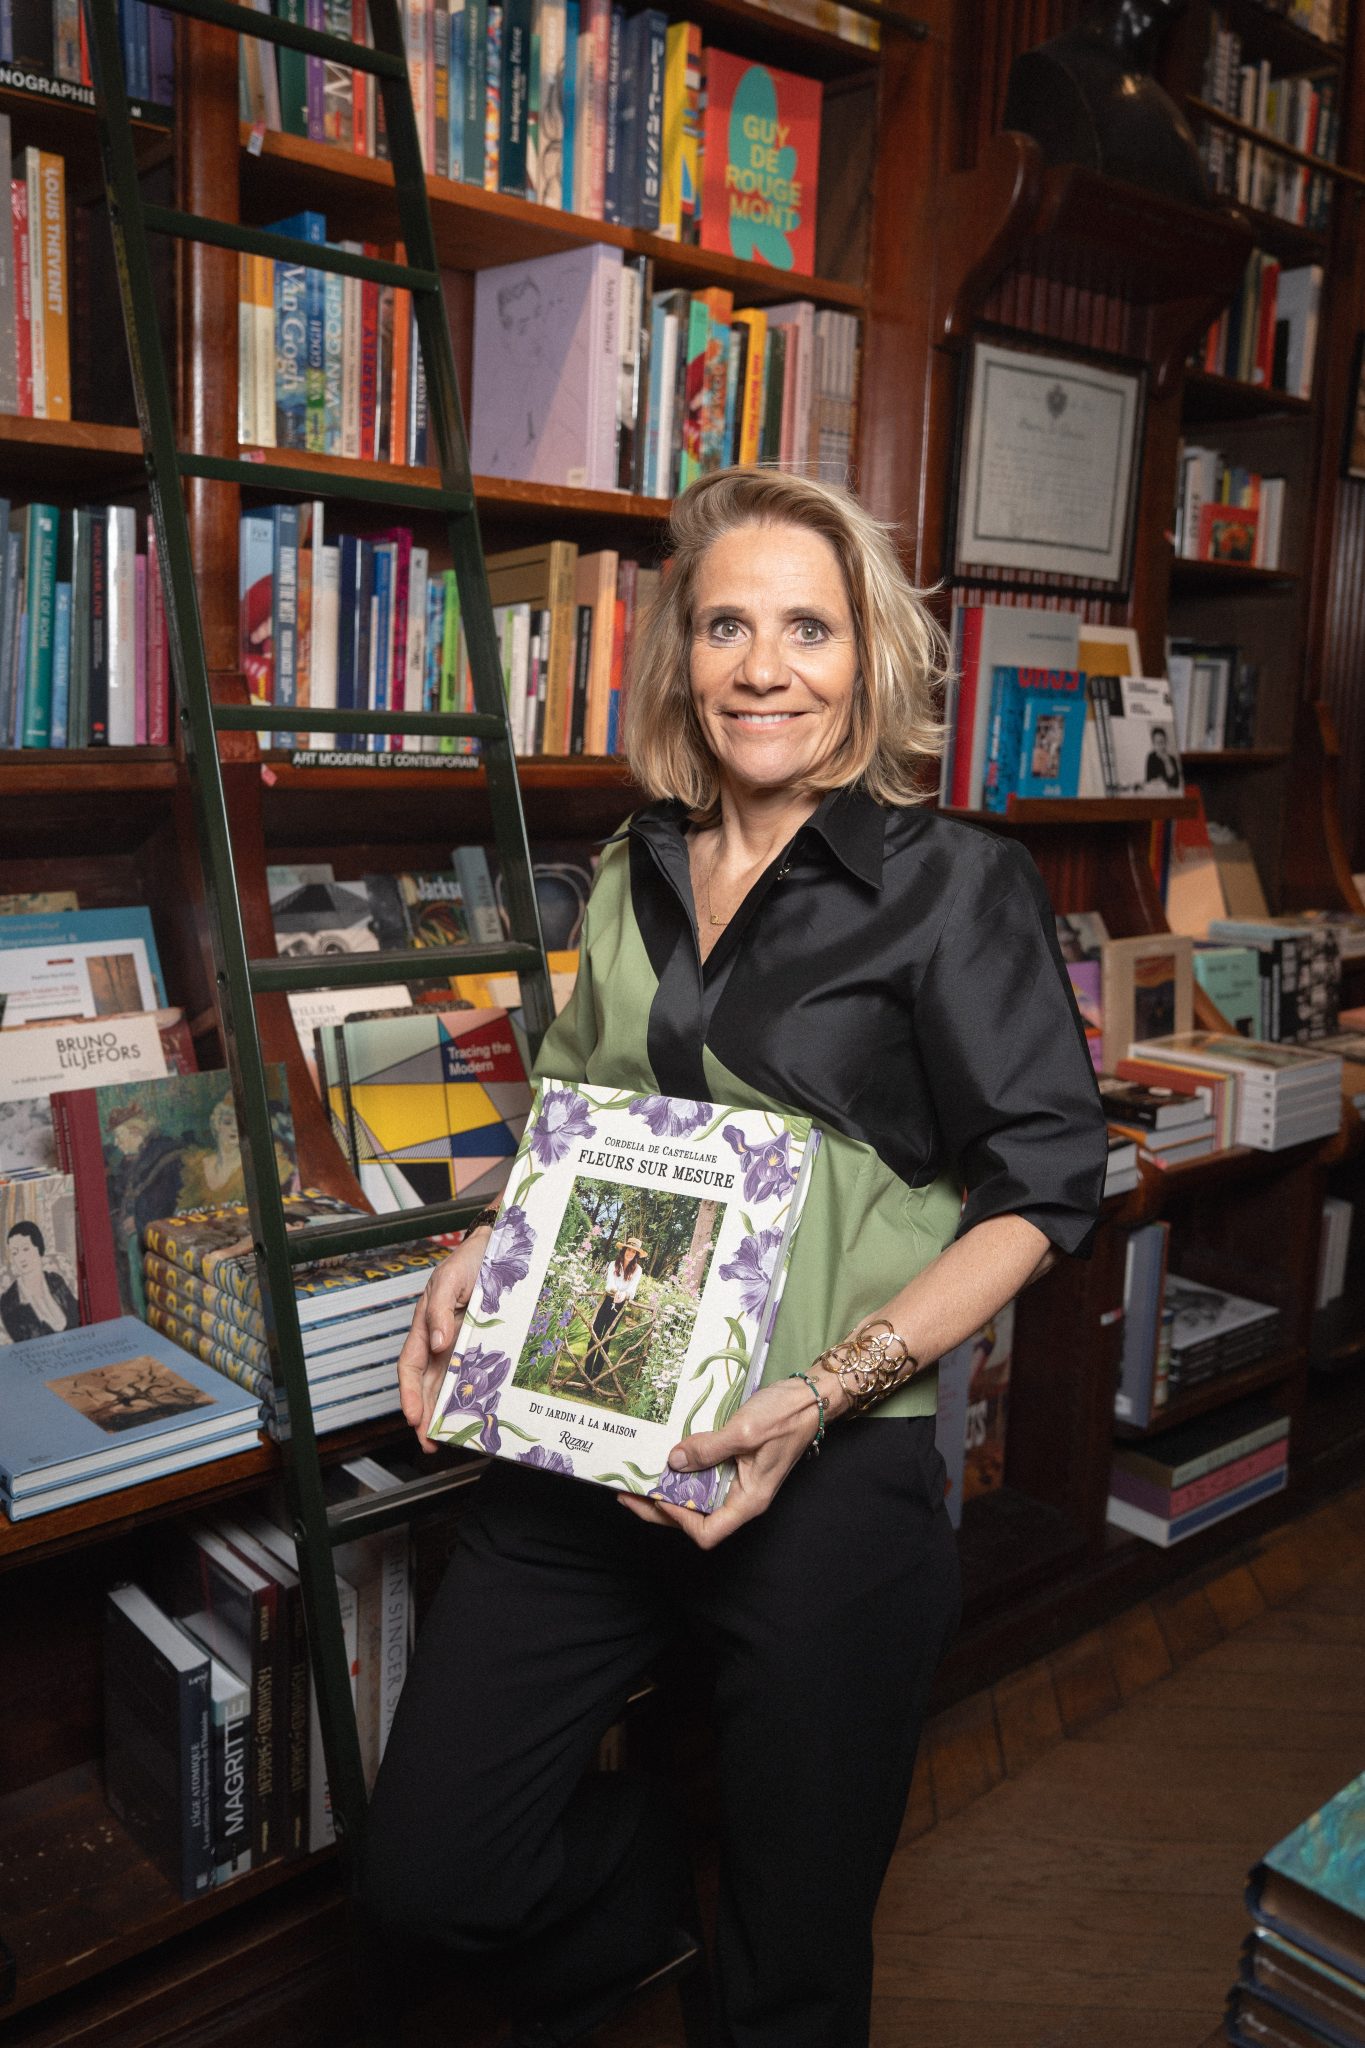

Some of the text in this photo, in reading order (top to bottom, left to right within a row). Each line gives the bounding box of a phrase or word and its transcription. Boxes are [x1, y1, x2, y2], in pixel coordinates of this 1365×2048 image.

[743, 114, 791, 146] GUY
[749, 144, 780, 175] DE
[725, 164, 802, 208] ROUGE
[729, 194, 800, 231] MONT
[43, 168, 63, 316] LOUIS THEVENET
[276, 265, 306, 391] Van Gogh
[307, 320, 322, 367] GOGH
[325, 285, 341, 408] VAN GOGH
[39, 617, 50, 648] ROME
[292, 752, 479, 769] ART MODERNE ET CONTEMPORAIN
[56, 1032, 118, 1054] BRUNO
[447, 1041, 512, 1061] Tracing the
[449, 1060, 495, 1077] Modern
[578, 1149, 736, 1190] FLEURS SUR MESURE
[604, 1136, 718, 1164] CORDELIA DE CASTELLANE
[529, 1402, 637, 1438] DU JARDIN À LA MAISON
[559, 1430, 594, 1450] RIZZOLI
[387, 1600, 403, 1691] SINGER
[257, 1666, 273, 1734] FASHIONED
[189, 1742, 202, 1828] L'ÂGE ATOMIQUE
[224, 1699, 245, 1836] MAGRITTE
[257, 1744, 273, 1796] SARGENT
